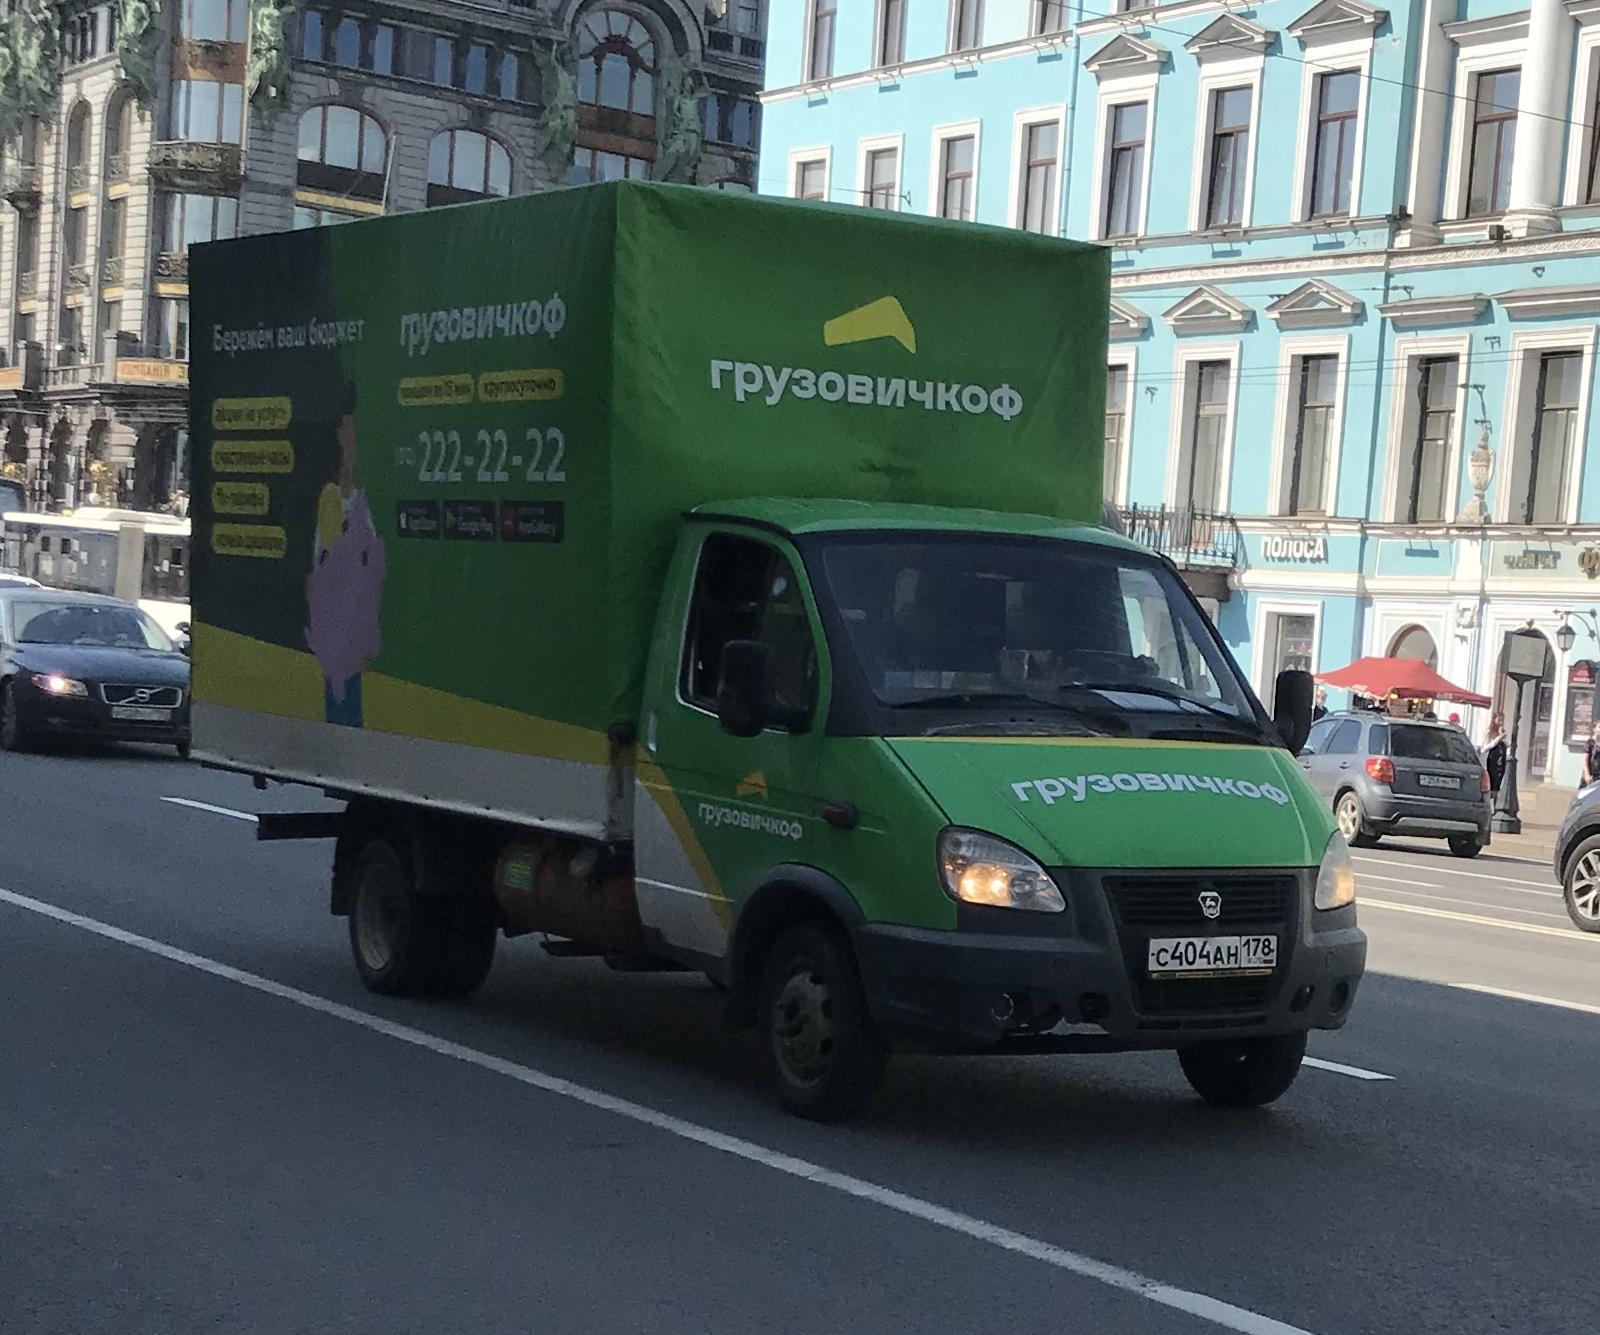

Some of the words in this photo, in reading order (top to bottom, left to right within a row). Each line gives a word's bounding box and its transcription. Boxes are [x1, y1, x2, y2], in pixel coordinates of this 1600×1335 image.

[278, 326, 306, 347] ваш
[309, 317, 364, 349] бюджет
[401, 292, 566, 357] грузовичкоф
[710, 359, 1023, 420] грузовичкоф
[418, 426, 566, 481] 222-22-22
[1261, 535, 1325, 560] ПОЛОСА
[1011, 772, 1289, 805] грузовичкоф
[698, 802, 803, 841] грузовичкоф
[1243, 938, 1272, 956] 178
